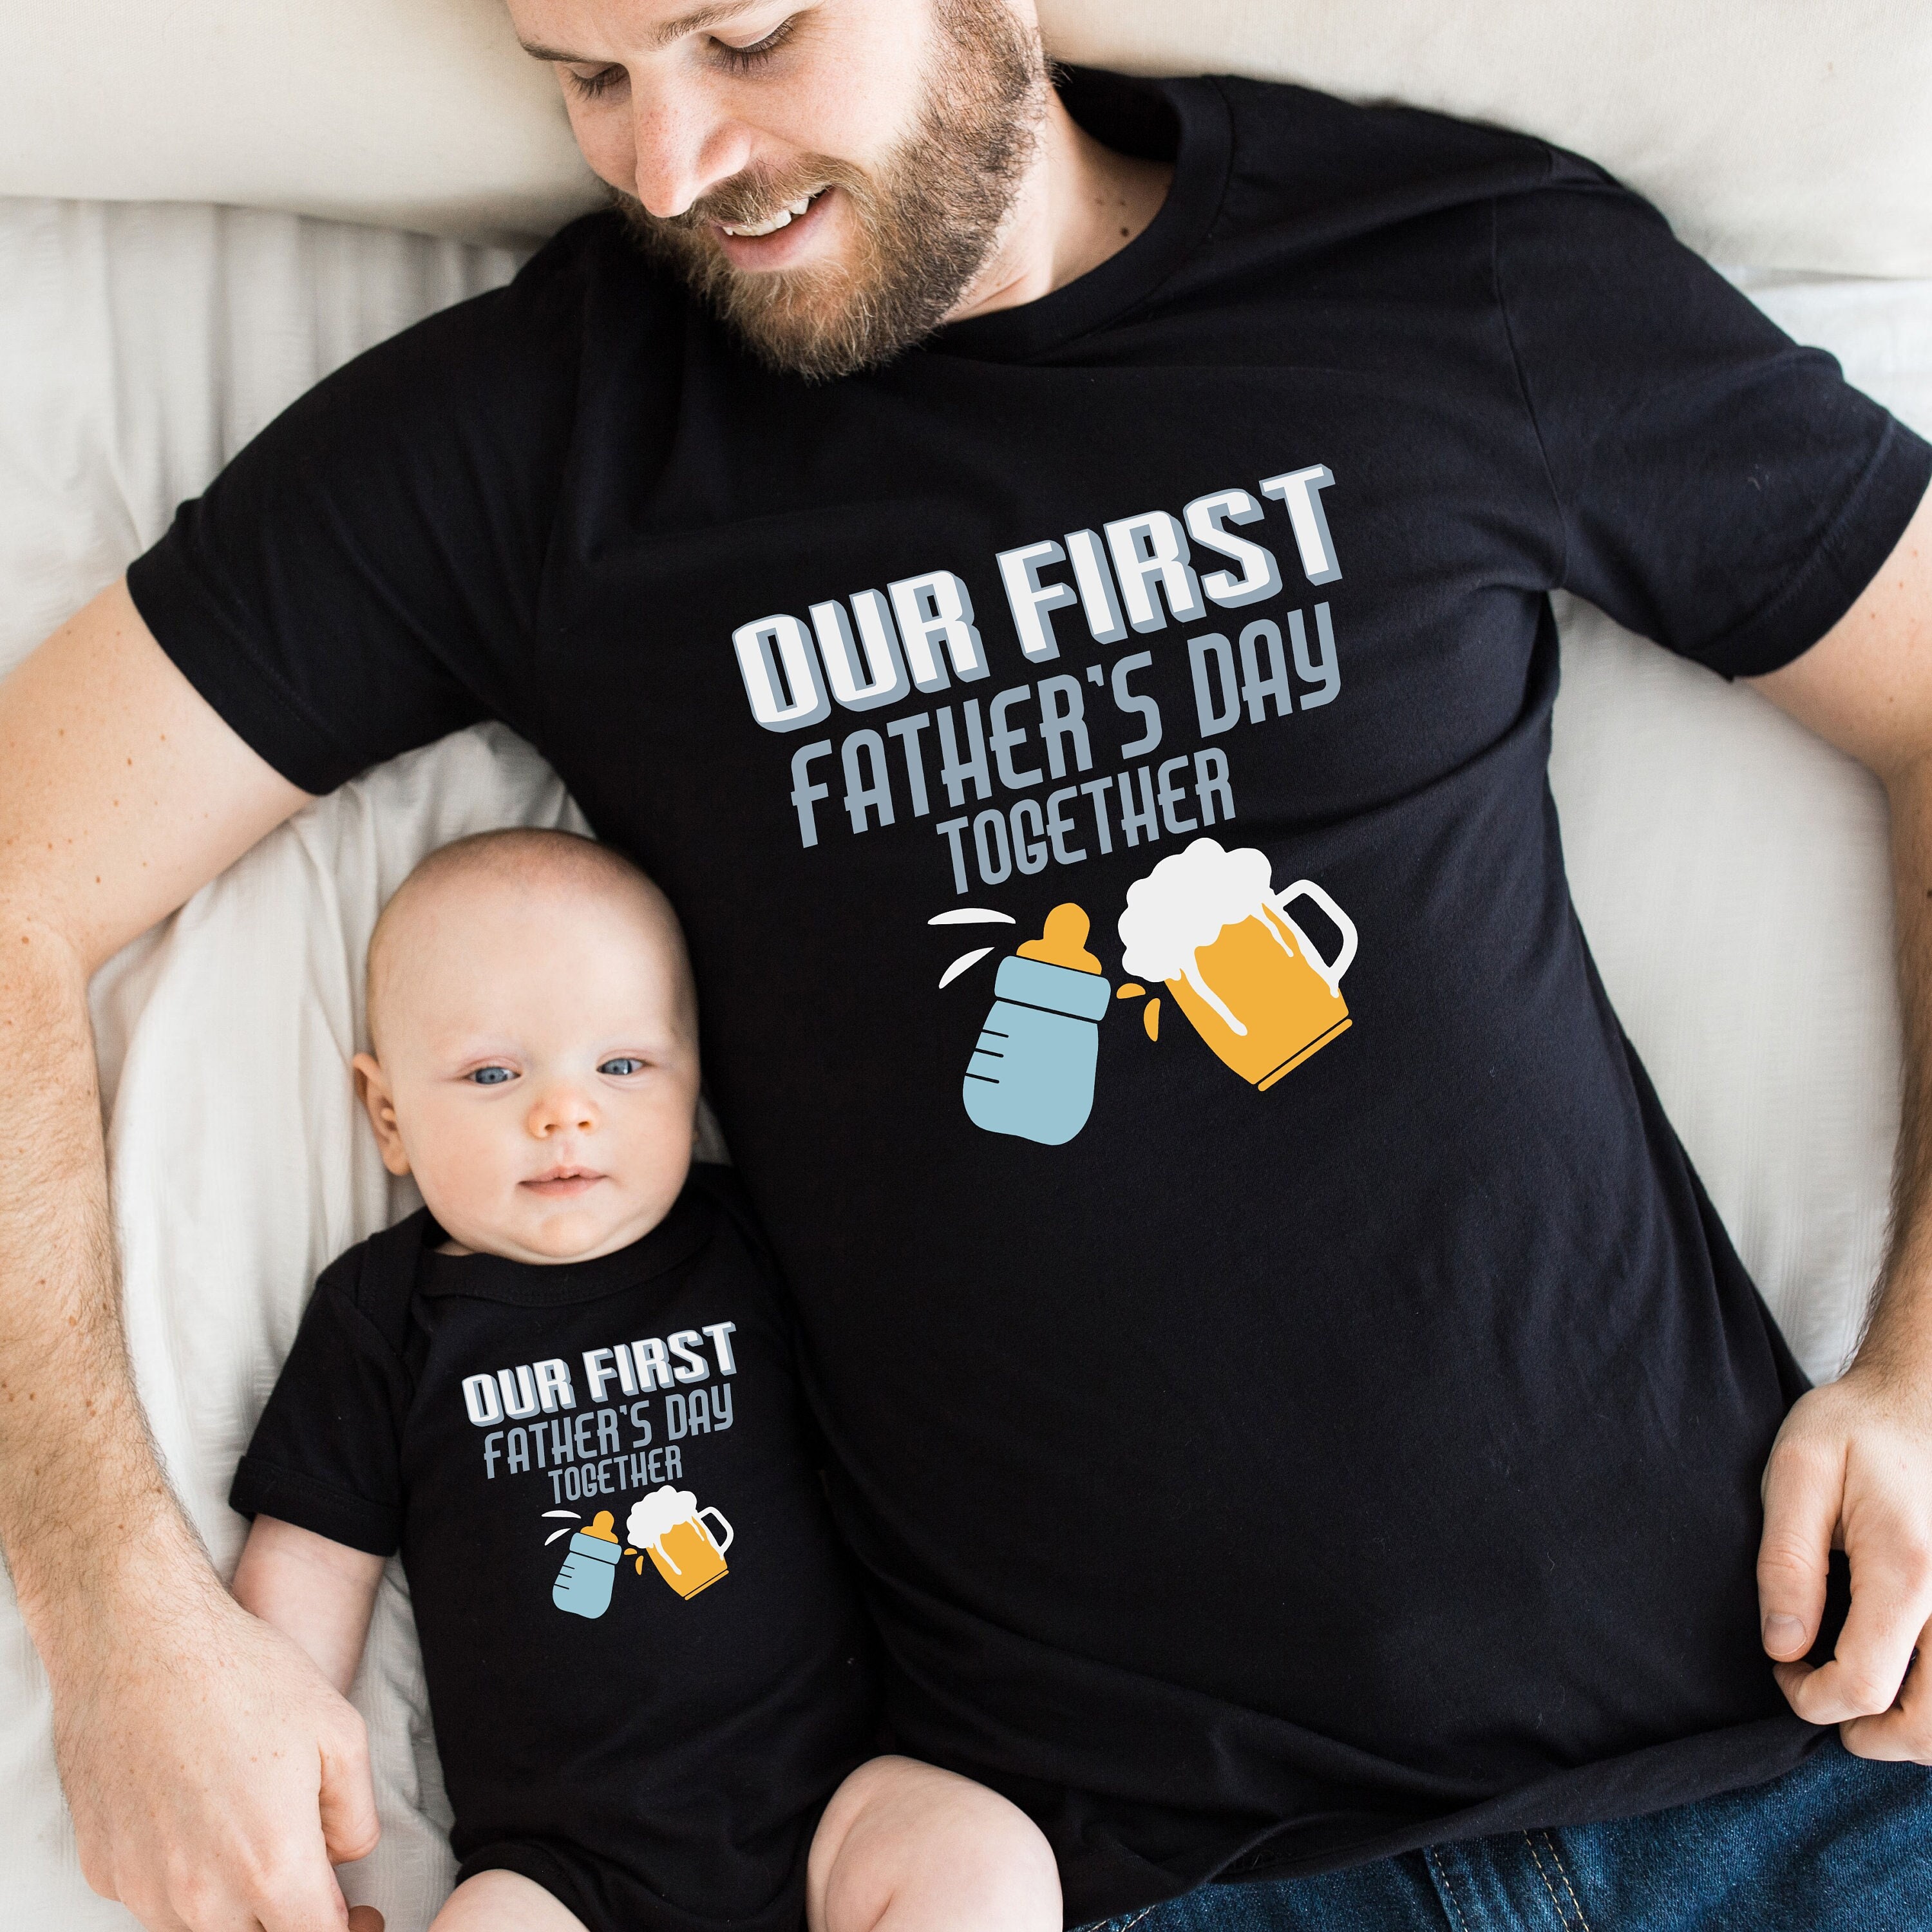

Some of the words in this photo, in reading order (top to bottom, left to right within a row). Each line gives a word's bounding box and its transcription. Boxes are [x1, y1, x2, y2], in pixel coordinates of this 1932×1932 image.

[732, 571, 990, 733] OUR
[996, 464, 1343, 663] FIRST
[791, 650, 1162, 848] FATHER'S
[1187, 601, 1341, 738] DAY
[936, 748, 1235, 895] TOGETHER
[462, 1358, 576, 1426] OUR
[582, 1321, 737, 1403] FIRST
[484, 1400, 652, 1479] FATHER'S
[665, 1383, 733, 1441] DAY
[548, 1445, 682, 1504] TOGETHER
